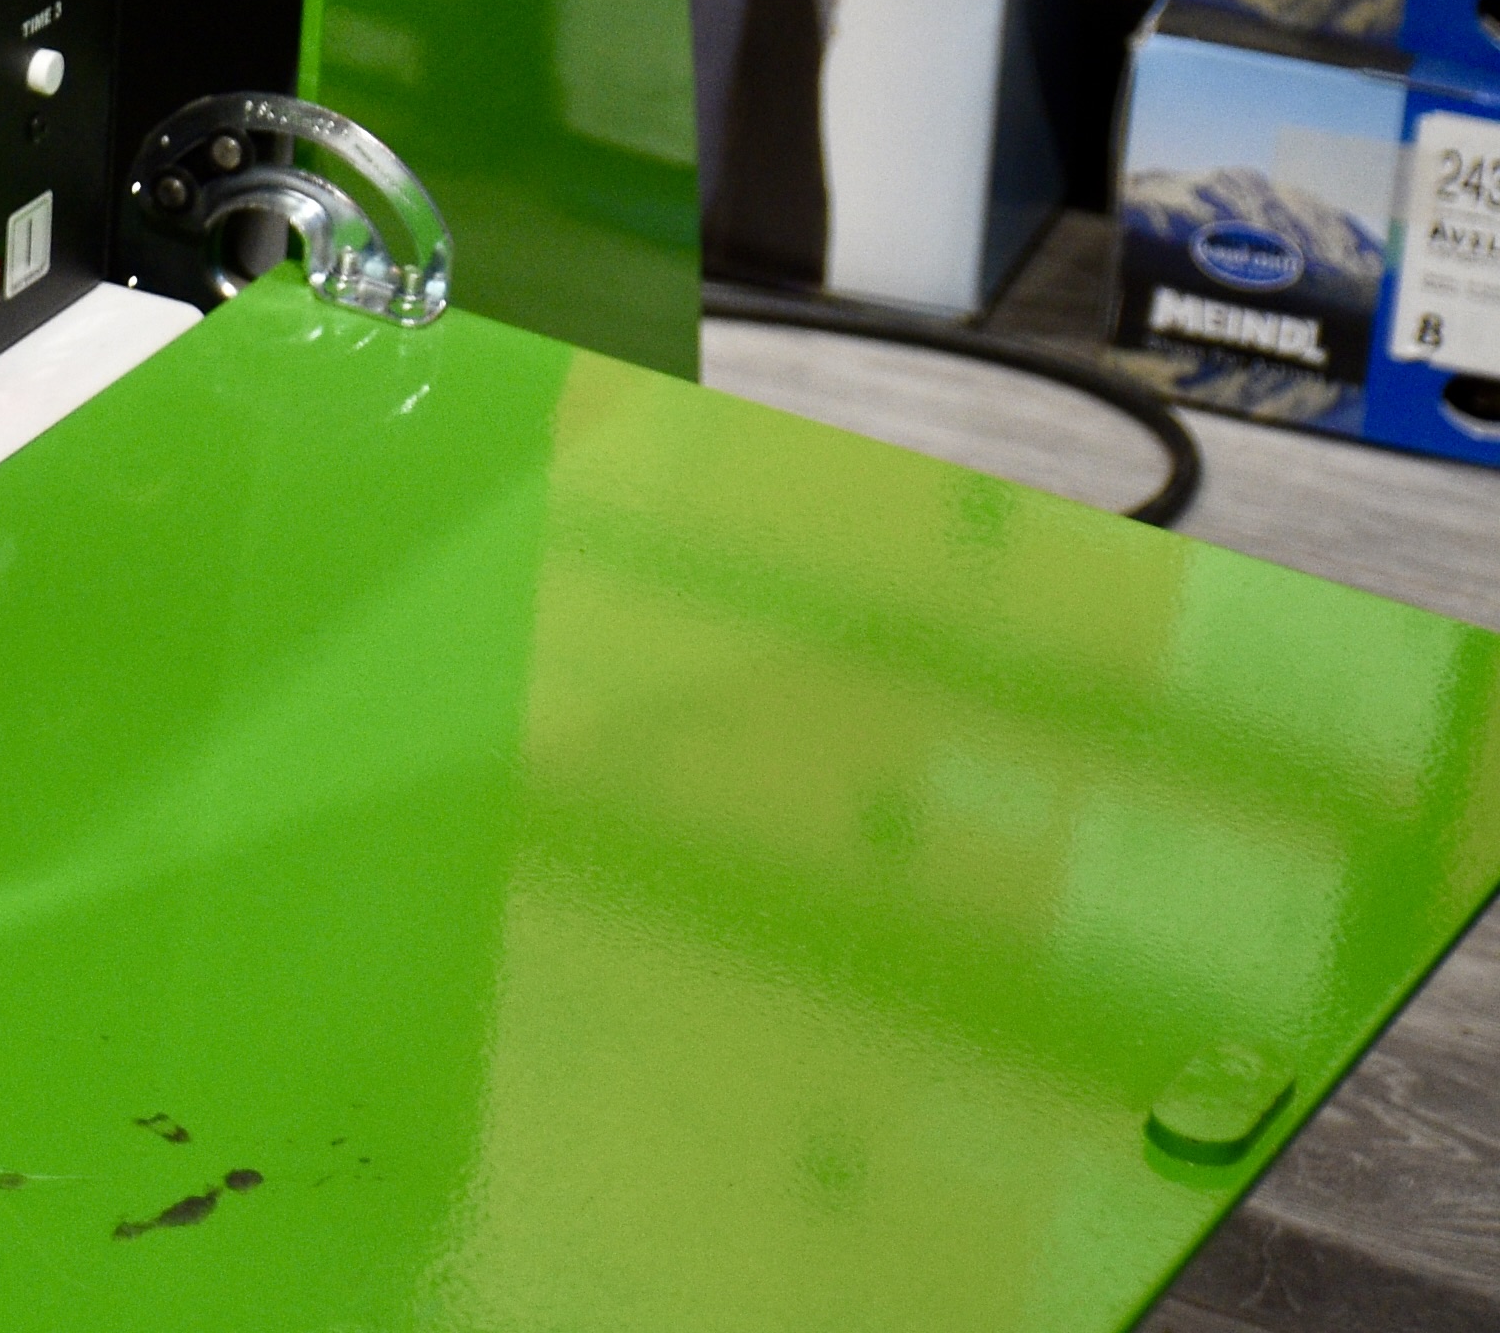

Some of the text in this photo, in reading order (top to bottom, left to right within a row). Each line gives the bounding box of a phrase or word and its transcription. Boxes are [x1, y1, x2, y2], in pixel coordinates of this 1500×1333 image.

[21, 0, 63, 39] TIME 3
[1150, 285, 1329, 369] MEINDL
